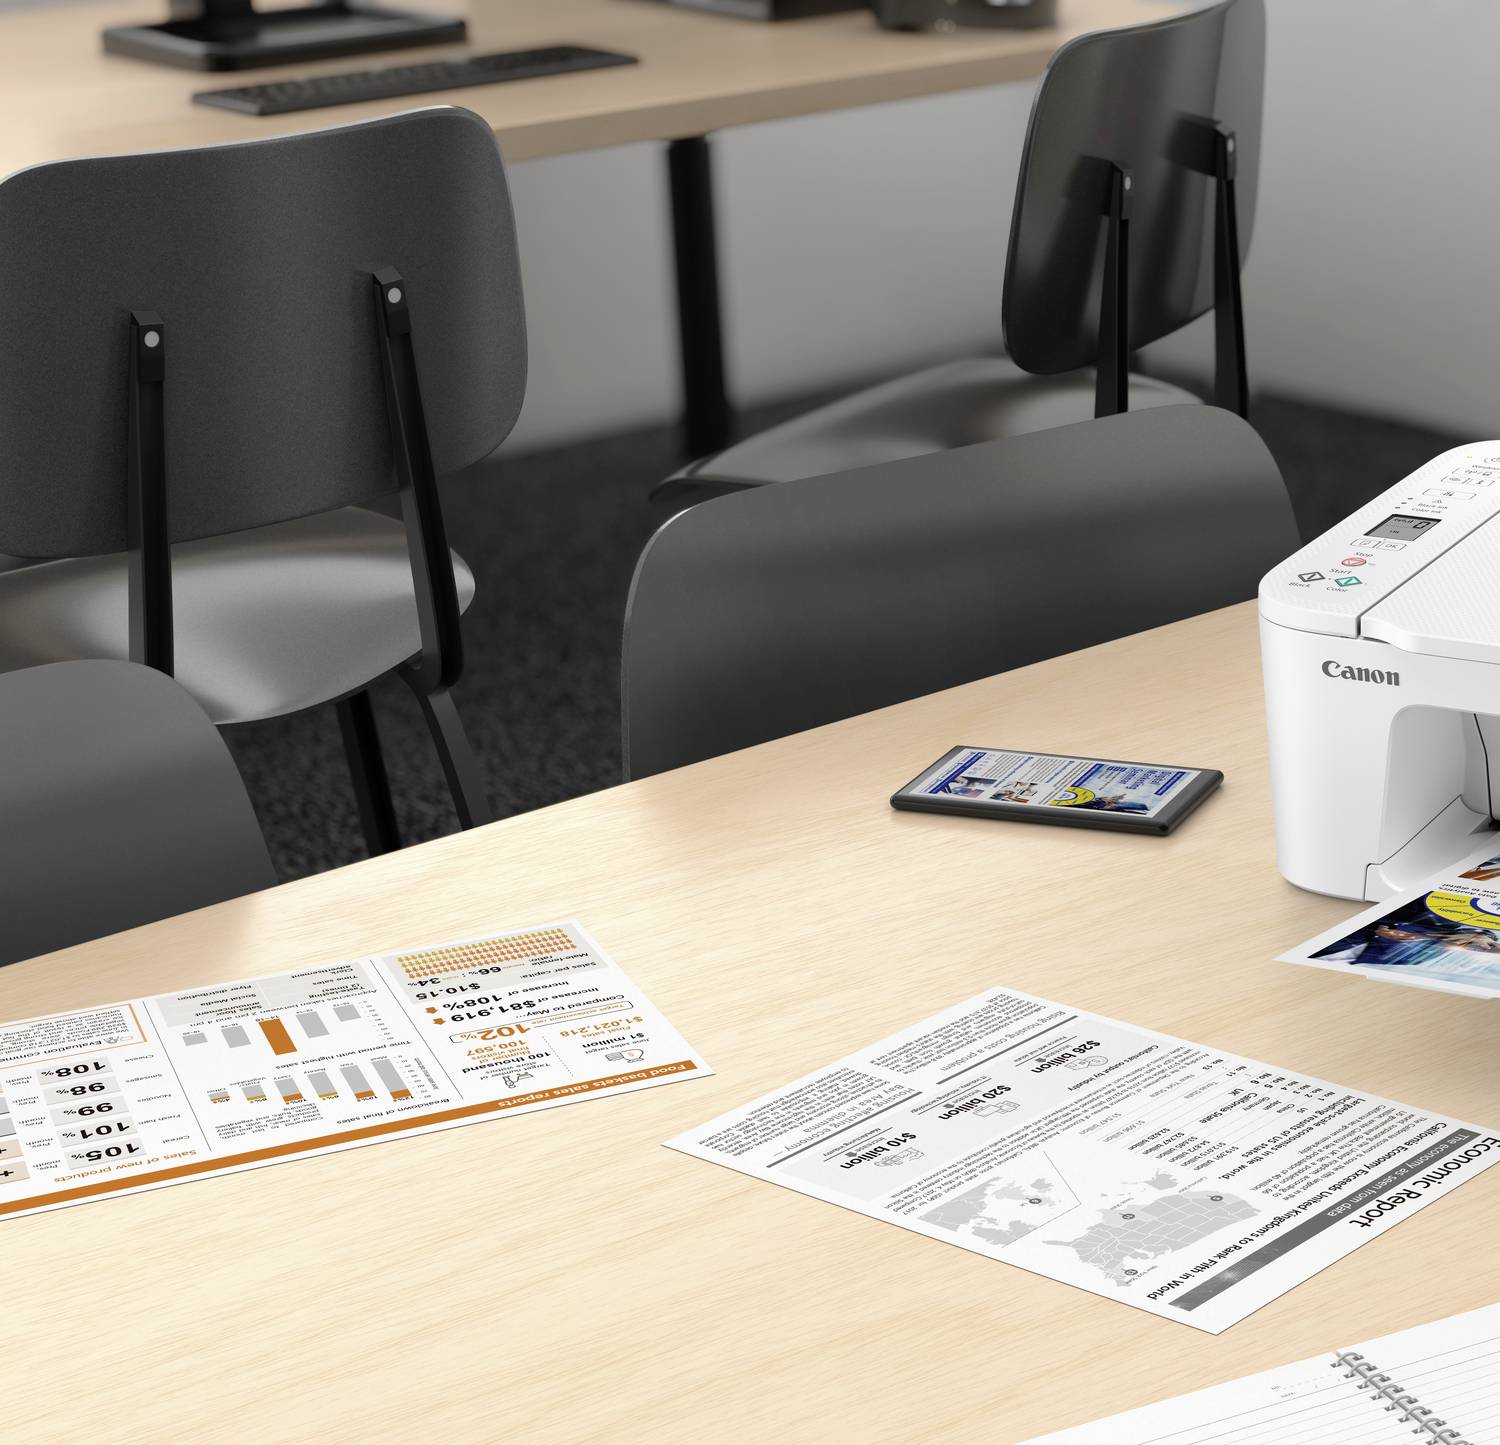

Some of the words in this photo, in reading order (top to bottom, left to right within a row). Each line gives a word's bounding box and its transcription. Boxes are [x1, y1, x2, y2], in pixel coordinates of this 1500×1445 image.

[1321, 660, 1400, 687] Canon
[468, 966, 502, 975] 66%
[407, 977, 441, 987] 34%
[522, 981, 569, 993] Increase
[416, 983, 481, 1000] $10.15
[551, 987, 599, 999] Increase
[442, 995, 502, 1011] 108%
[567, 994, 625, 1009] Compared
[451, 1000, 536, 1022] $81,919
[559, 1015, 643, 1038] $1,021,218
[582, 1036, 626, 1048] million
[630, 1032, 645, 1040] $1
[357, 1044, 387, 1054] period
[467, 1039, 527, 1057] 100,597
[1072, 1040, 1101, 1054] $26
[301, 1055, 334, 1065] highest
[528, 1051, 551, 1060] 100
[1031, 1052, 1077, 1073] billion
[41, 1061, 106, 1078] 108%
[275, 1062, 299, 1070] sales
[462, 1056, 525, 1074] thousand
[649, 1064, 686, 1076] Food
[592, 1072, 647, 1087] baskets
[56, 1082, 105, 1096] 98%
[553, 1084, 589, 1096] sales
[982, 1085, 1012, 1099] $20
[1228, 1088, 1245, 1097] UK
[397, 1098, 450, 1112] Breakdown
[498, 1092, 550, 1107] reports
[1219, 1092, 1258, 1113] California
[1314, 1095, 1355, 1116] including
[63, 1102, 113, 1116] 99%
[363, 1112, 384, 1120] final
[938, 1098, 986, 1120] billion
[1313, 1098, 1366, 1127] Largest-scale
[336, 1116, 361, 1125] sales
[1199, 1111, 1223, 1124] State
[1289, 1114, 1318, 1131] results
[62, 1122, 130, 1139] 101%
[1404, 1122, 1447, 1146] California
[886, 1132, 917, 1147] $10
[1267, 1135, 1283, 1144] US
[1270, 1126, 1314, 1151] economies
[1446, 1133, 1470, 1145] The
[71, 1143, 139, 1162] 105%
[163, 1151, 197, 1160] Sales
[840, 1146, 890, 1169] billion
[1241, 1142, 1269, 1158] states
[1363, 1145, 1409, 1170] Economy
[1405, 1144, 1449, 1169] economy
[116, 1160, 143, 1170] new
[1246, 1156, 1264, 1165] the
[54, 1167, 112, 1183] products
[1218, 1164, 1248, 1180] world,
[1394, 1167, 1409, 1176] as
[1328, 1169, 1369, 1192] Exceeds
[1372, 1175, 1397, 1190] seen
[1297, 1191, 1333, 1211] United
[1349, 1188, 1377, 1203] from
[1327, 1202, 1352, 1217] data
[1349, 1188, 1422, 1228] Report
[1250, 1209, 1302, 1238] Kingdom's
[1238, 1237, 1255, 1245] to
[1213, 1244, 1243, 1260] Rank
[1190, 1258, 1218, 1273] Fifth
[1179, 1272, 1195, 1280] in
[1146, 1280, 1184, 1300] World
